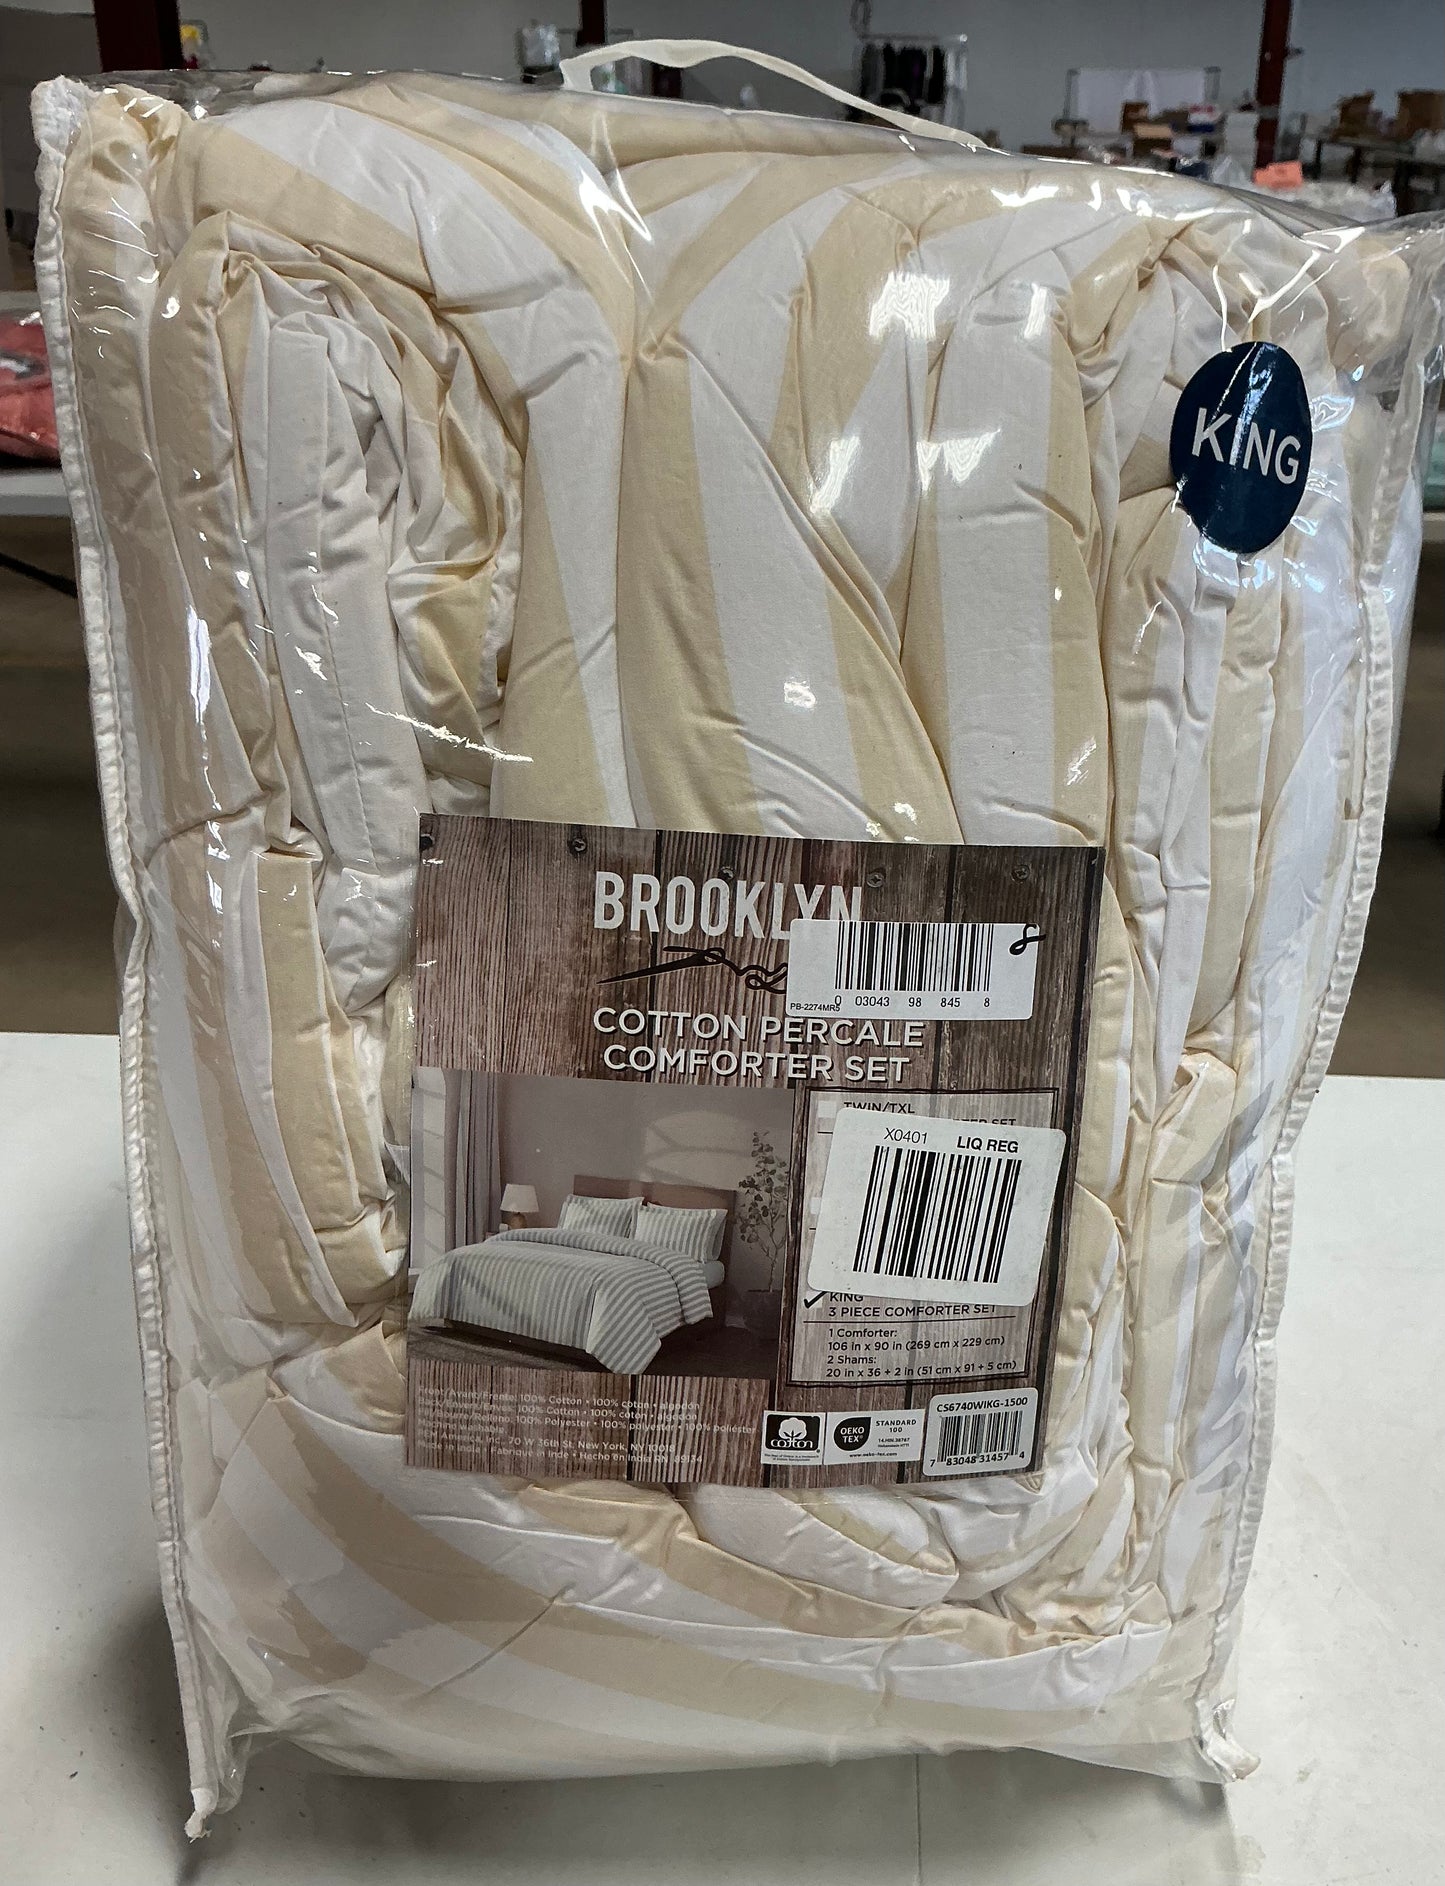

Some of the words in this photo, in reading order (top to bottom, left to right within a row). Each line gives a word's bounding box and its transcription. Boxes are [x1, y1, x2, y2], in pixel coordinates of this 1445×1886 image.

[1192, 407, 1301, 485] KING
[593, 870, 862, 940] BROOKLYN
[790, 1003, 840, 1012] PB-2274MR5
[834, 996, 842, 1006] 0
[855, 996, 890, 1007] 03043
[908, 997, 922, 1008] 98
[940, 997, 961, 1008] 845
[983, 997, 991, 1008] 8
[593, 1007, 747, 1040] COTTON
[761, 1016, 925, 1047] PERCALE
[603, 1044, 833, 1080] COMFORTER
[845, 1056, 910, 1082] SET
[884, 1127, 928, 1144] X0401
[957, 1136, 983, 1150] LIQ
[986, 1138, 1019, 1154] REG
[829, 1292, 864, 1302] KING
[828, 1307, 837, 1317] 3
[841, 1306, 880, 1317] PIECE
[884, 1304, 969, 1317] COMFORTER
[973, 1304, 996, 1314] SET
[829, 1329, 833, 1338] 1
[837, 1328, 897, 1338] Comforter:
[828, 1341, 847, 1351] 106
[851, 1341, 861, 1351] in
[874, 1341, 889, 1351] 90
[892, 1341, 902, 1350] in
[905, 1339, 931, 1351] (269
[962, 1337, 982, 1347] 229
[985, 1335, 1005, 1346] cm)
[827, 1355, 834, 1364] 2
[837, 1355, 877, 1365] Shams:
[826, 1368, 841, 1377] 20
[844, 1367, 854, 1377] in
[867, 1367, 881, 1377] 36
[895, 1367, 901, 1376] 2
[904, 1367, 914, 1376] in
[917, 1365, 933, 1377] (51
[964, 1363, 975, 1372] 91
[987, 1362, 994, 1371] 5
[997, 1360, 1017, 1371] cm)
[521, 1393, 546, 1403] 100%
[549, 1395, 582, 1406] Cotton
[593, 1398, 619, 1408] 100%
[621, 1400, 650, 1409] coton
[937, 1397, 1028, 1412] CS6740WIKG-1500
[518, 1404, 543, 1414] 100%
[546, 1405, 580, 1415] Cotton
[590, 1408, 617, 1418] 100%
[619, 1410, 648, 1420] coton
[516, 1415, 542, 1425] 100%
[544, 1417, 589, 1428] Polyester
[601, 1420, 627, 1429] 100%
[685, 1423, 710, 1432] 100%
[876, 1418, 917, 1426] STANDARD
[840, 1426, 865, 1435] OEKO
[508, 1436, 521, 1446] 70
[523, 1437, 535, 1446] W
[538, 1438, 560, 1448] 36th
[577, 1441, 599, 1450] New
[630, 1443, 645, 1452] NY
[771, 1438, 814, 1449] cotton
[548, 1450, 569, 1459] Inde
[579, 1452, 611, 1461] Hecho
[613, 1453, 625, 1461] en
[930, 1459, 936, 1467] 7
[946, 1456, 977, 1466] 83048
[979, 1452, 1009, 1463] 31457
[1019, 1451, 1025, 1459] 4
